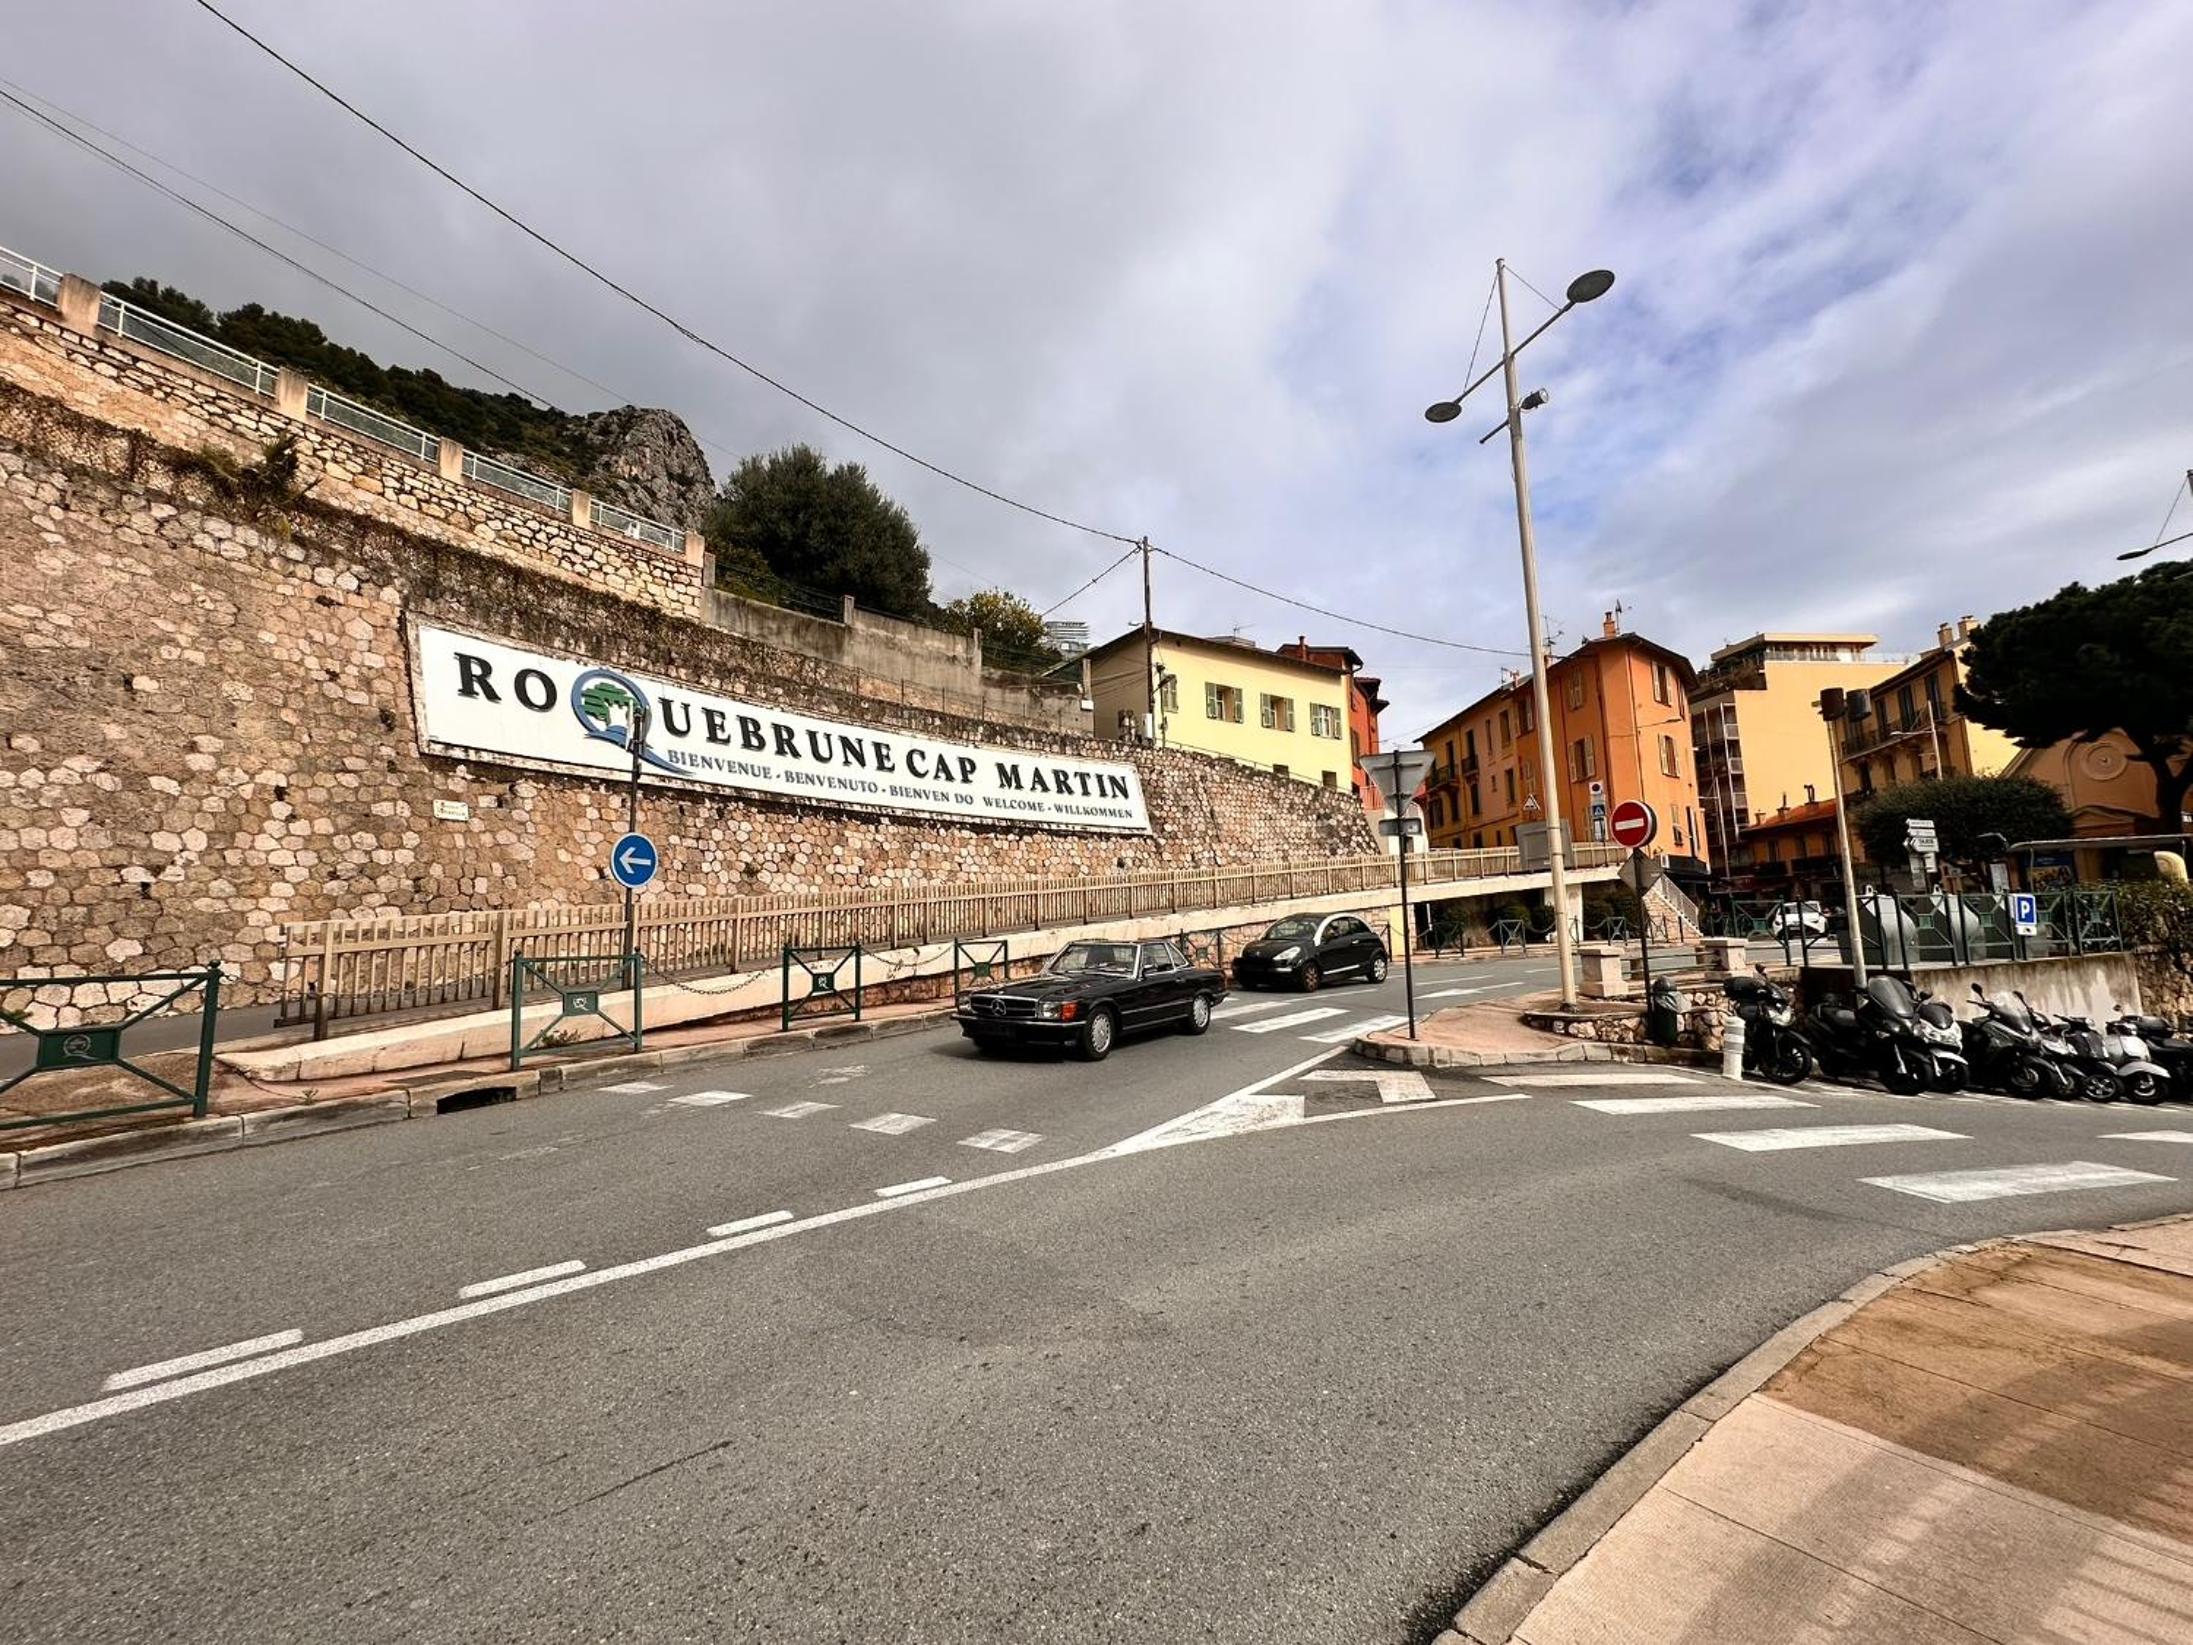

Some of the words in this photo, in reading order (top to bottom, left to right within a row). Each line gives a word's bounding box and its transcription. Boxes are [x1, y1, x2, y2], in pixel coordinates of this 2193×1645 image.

[668, 749, 772, 780] BIENVENUE
[784, 770, 878, 795] BENVENUTO
[983, 796, 1044, 812] WELCOME
[1054, 803, 1133, 819] WILLKOMMEN
[906, 748, 977, 784] CAP
[995, 762, 1130, 800] MARTIN
[2021, 901, 2030, 919] P
